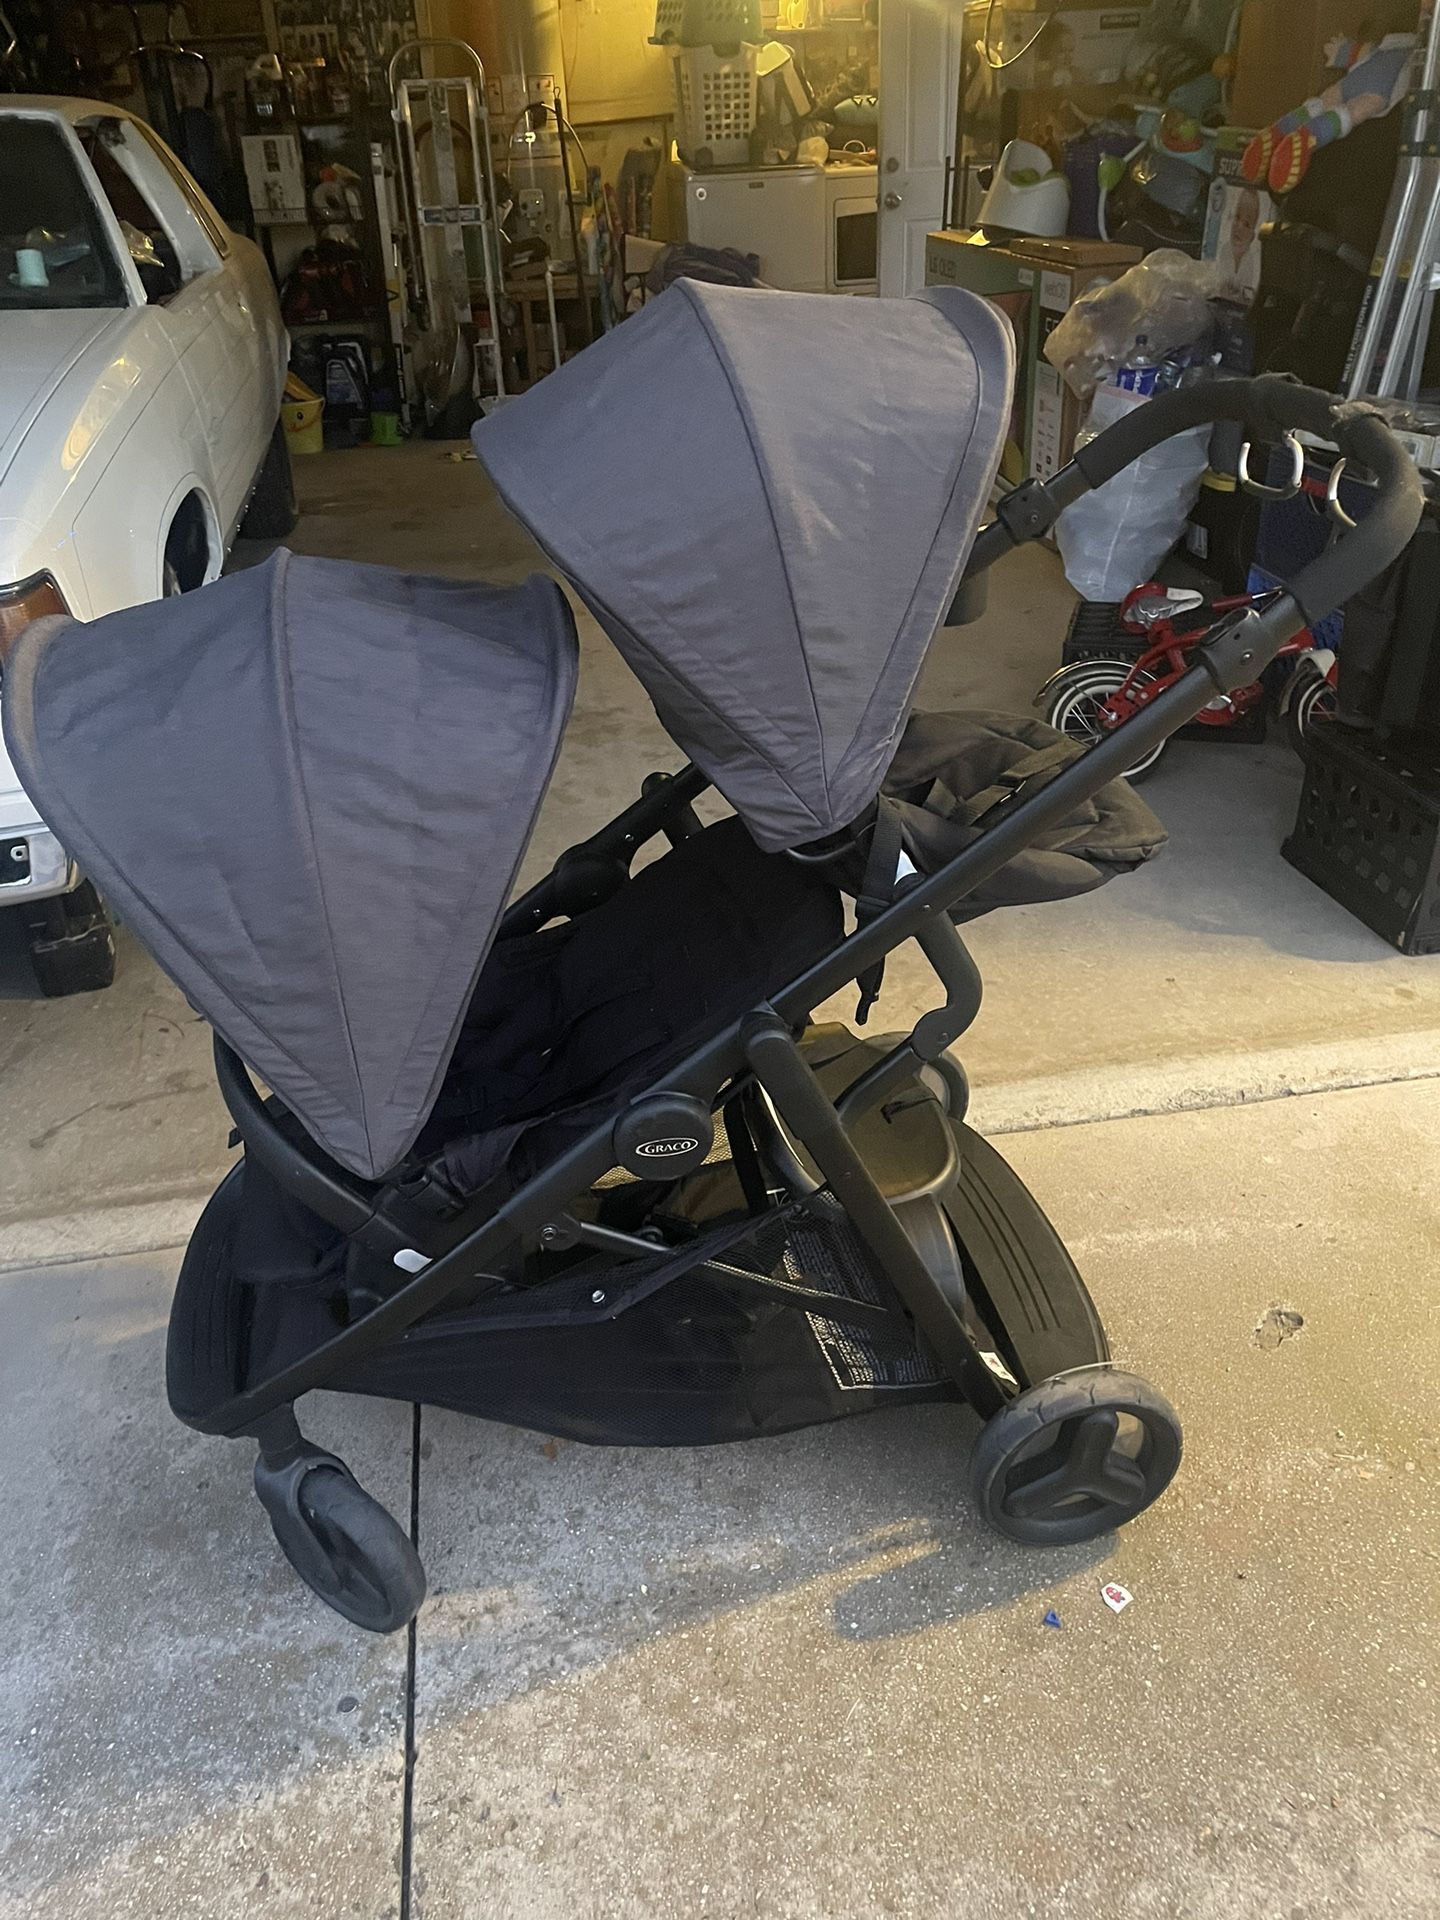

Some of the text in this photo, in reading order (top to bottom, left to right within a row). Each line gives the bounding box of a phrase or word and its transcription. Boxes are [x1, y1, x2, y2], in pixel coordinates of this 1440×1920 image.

[939, 257, 957, 279] OLED
[1350, 305, 1369, 350] POSITION
[1363, 284, 1373, 304] PRO
[644, 1141, 691, 1154] GRACO
